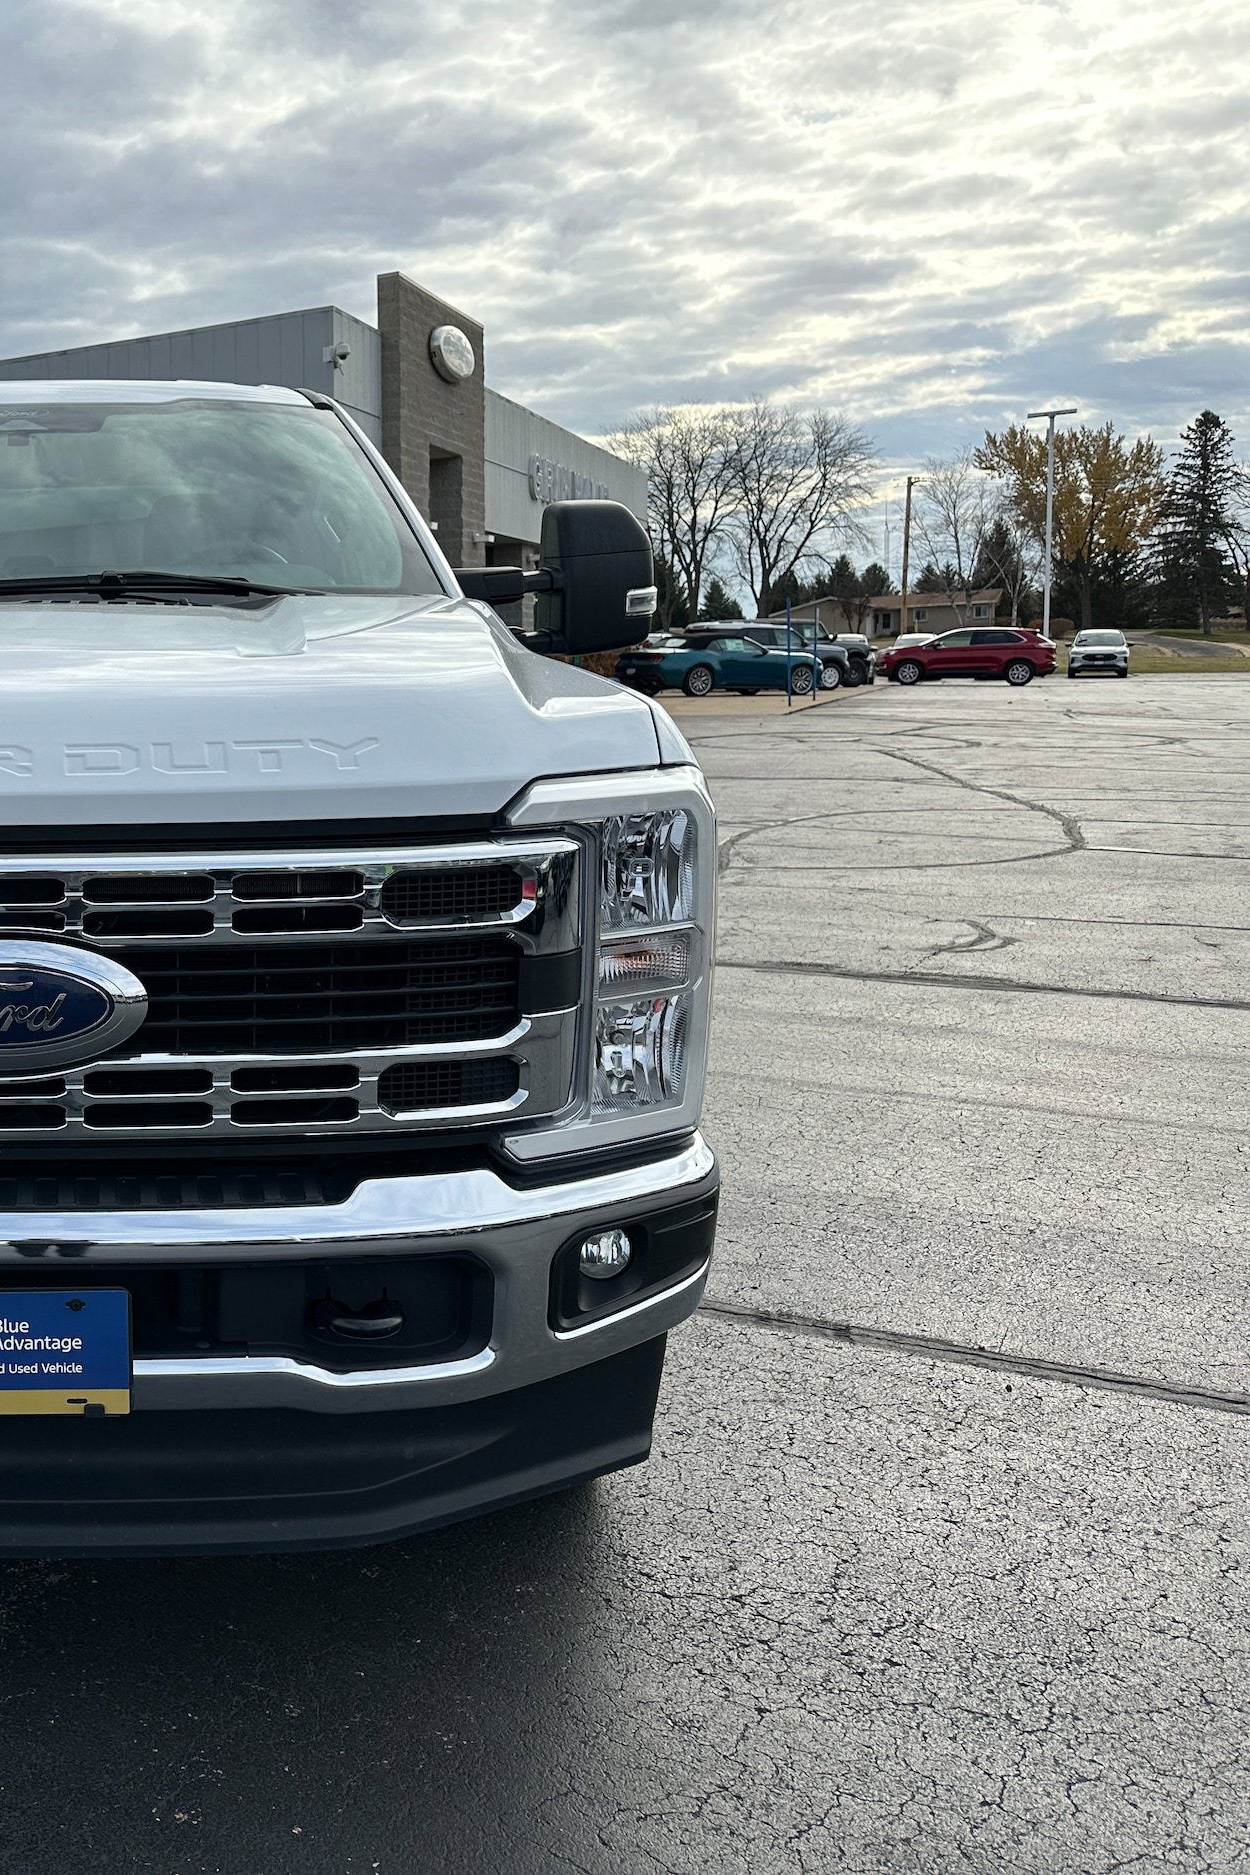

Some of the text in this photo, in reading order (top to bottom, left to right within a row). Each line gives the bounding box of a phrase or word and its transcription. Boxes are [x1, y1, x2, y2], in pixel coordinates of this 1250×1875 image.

[62, 736, 381, 776] DUTY
[8, 1363, 39, 1374] Used
[41, 1362, 84, 1374] Vehicle
